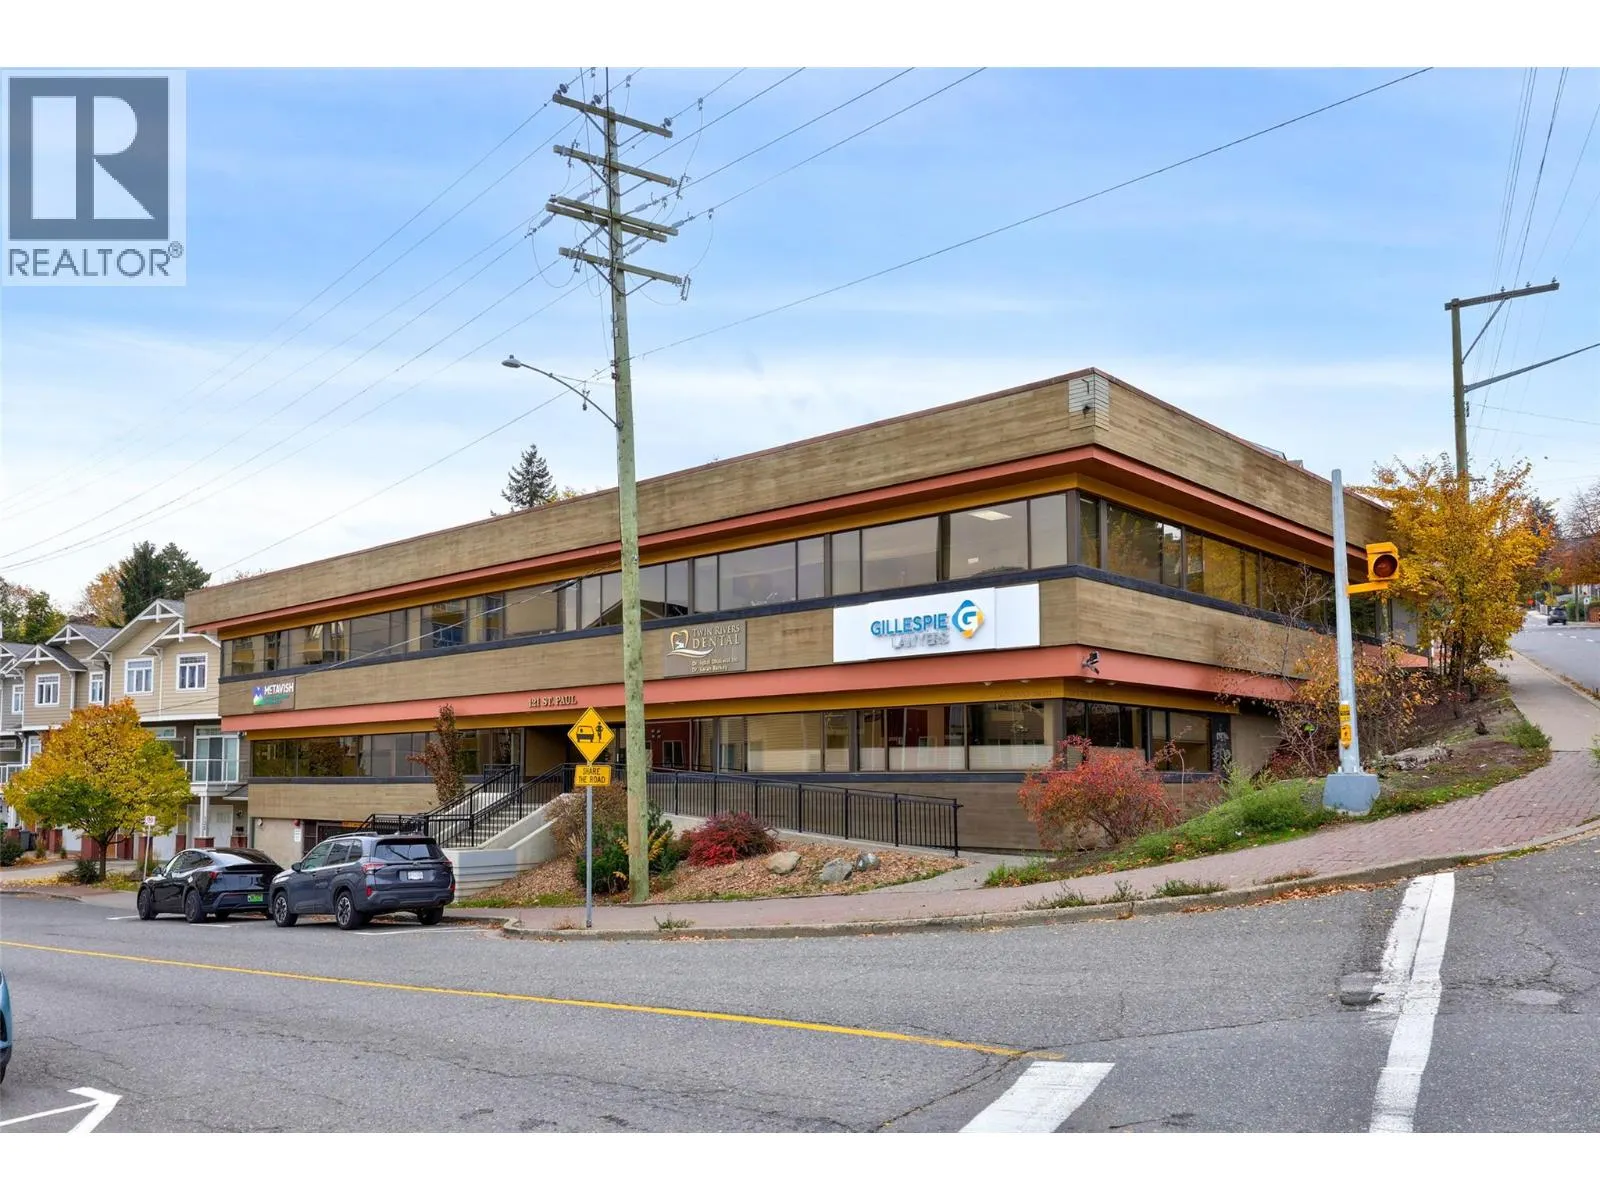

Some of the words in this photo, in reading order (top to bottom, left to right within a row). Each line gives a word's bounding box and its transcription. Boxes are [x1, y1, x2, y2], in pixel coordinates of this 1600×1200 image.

[692, 627, 712, 638] TWIN
[715, 623, 740, 635] RIVERS
[870, 612, 948, 636] GILLESPIE
[692, 633, 741, 649] DENTAL
[528, 697, 541, 707] 121
[555, 695, 577, 706] PAUL
[582, 767, 601, 776] SHARE
[578, 775, 587, 784] THE
[589, 775, 606, 784] ROAD
